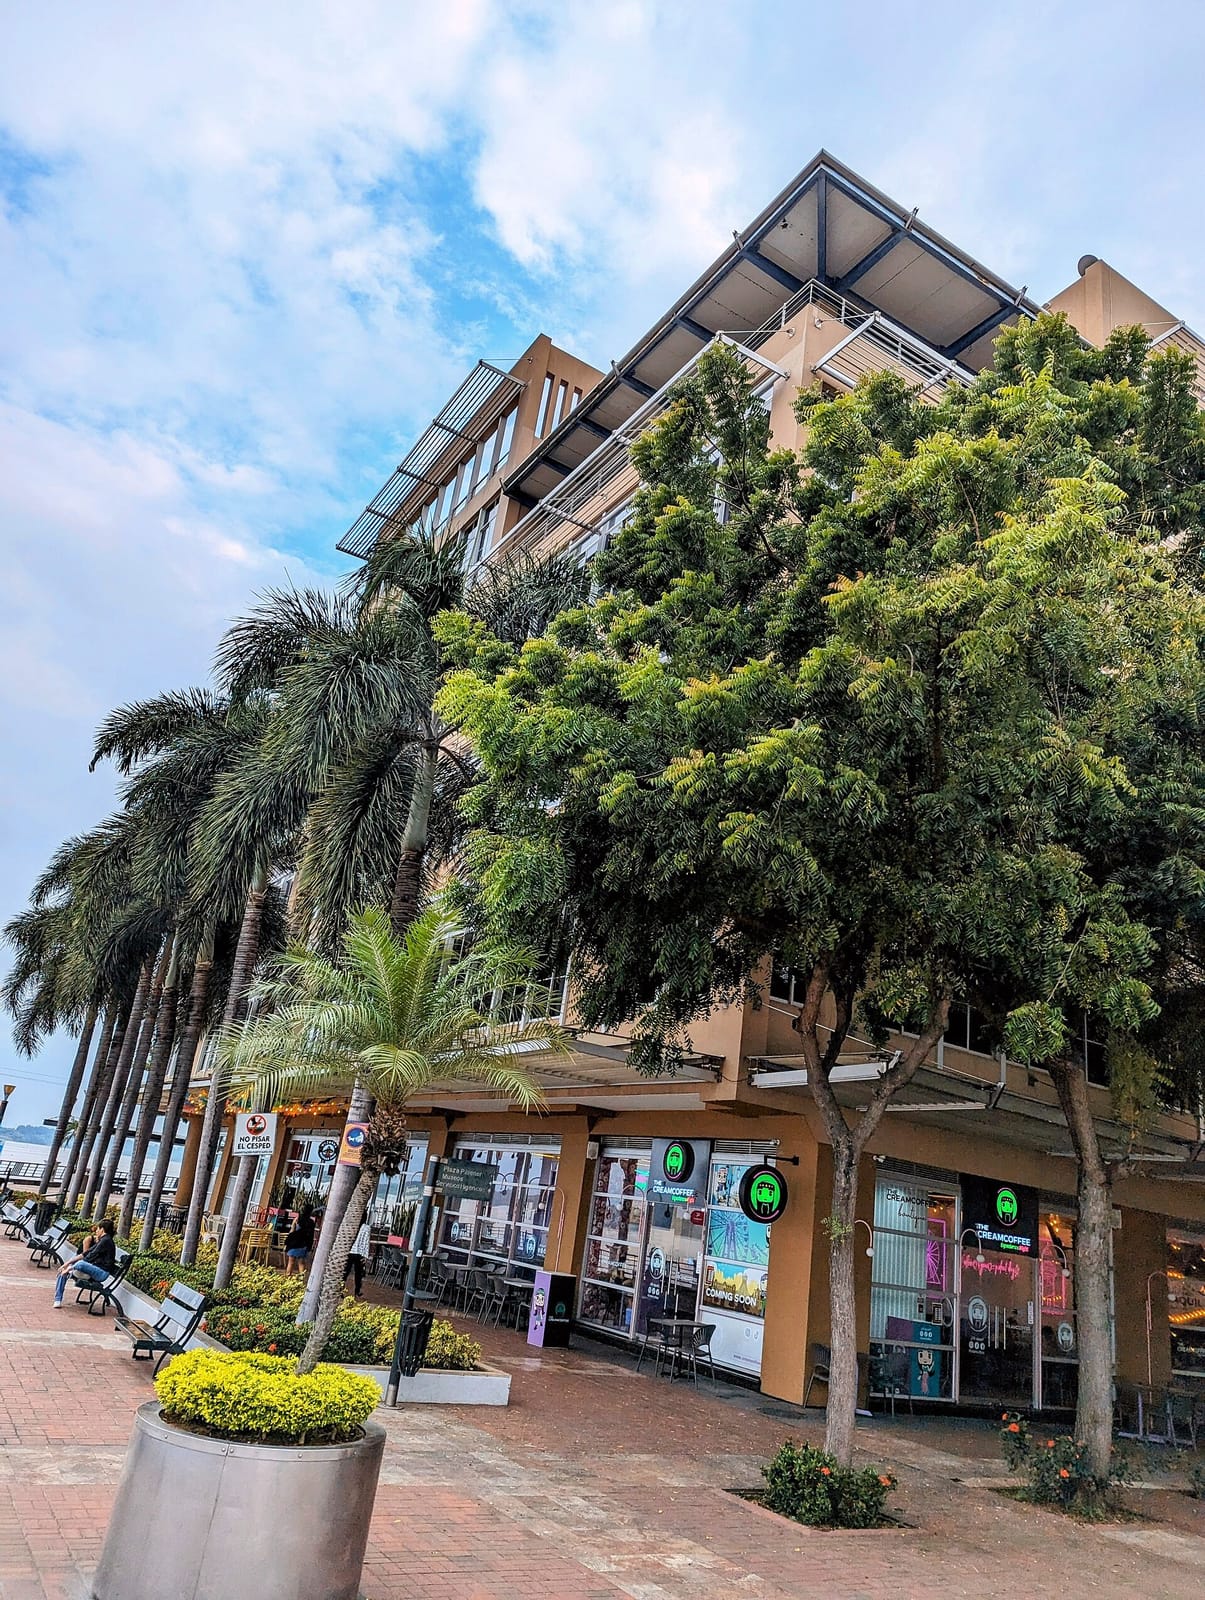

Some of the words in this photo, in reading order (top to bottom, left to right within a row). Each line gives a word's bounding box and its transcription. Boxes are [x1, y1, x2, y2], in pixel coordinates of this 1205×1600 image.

[239, 1135, 250, 1143] NO
[251, 1135, 270, 1143] PISAR
[246, 1142, 271, 1150] CESPED
[442, 1173, 464, 1182] Museos
[652, 1185, 694, 1197] CREAMCOFFEE
[976, 1223, 989, 1231] THE
[977, 1230, 1031, 1247] CREAMCOFFEE
[705, 1288, 733, 1302] COMING
[734, 1293, 757, 1306] SOON
